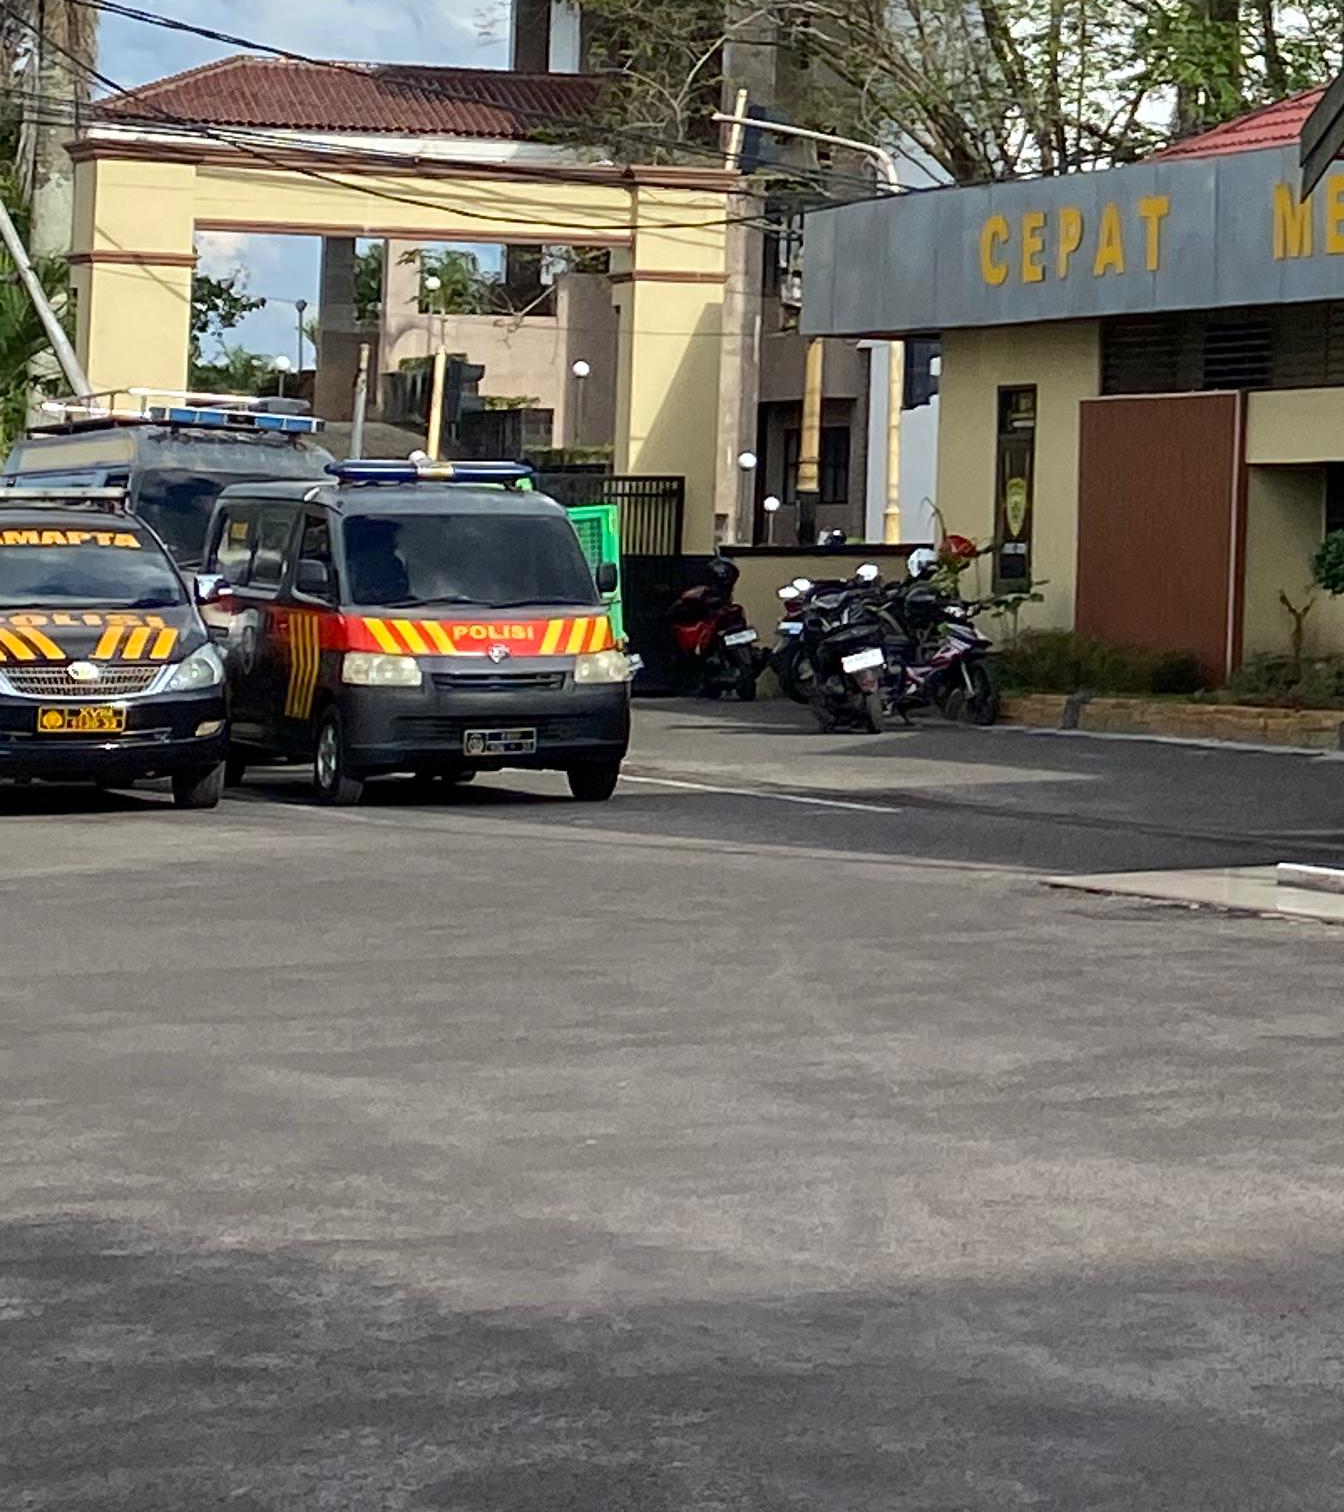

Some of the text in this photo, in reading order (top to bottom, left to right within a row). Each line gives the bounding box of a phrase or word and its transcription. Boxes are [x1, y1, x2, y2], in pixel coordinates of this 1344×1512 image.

[980, 195, 1169, 286] CEPAT
[0, 530, 141, 548] MAPTA
[0, 612, 167, 628] OLISI
[452, 625, 535, 640] POLISI
